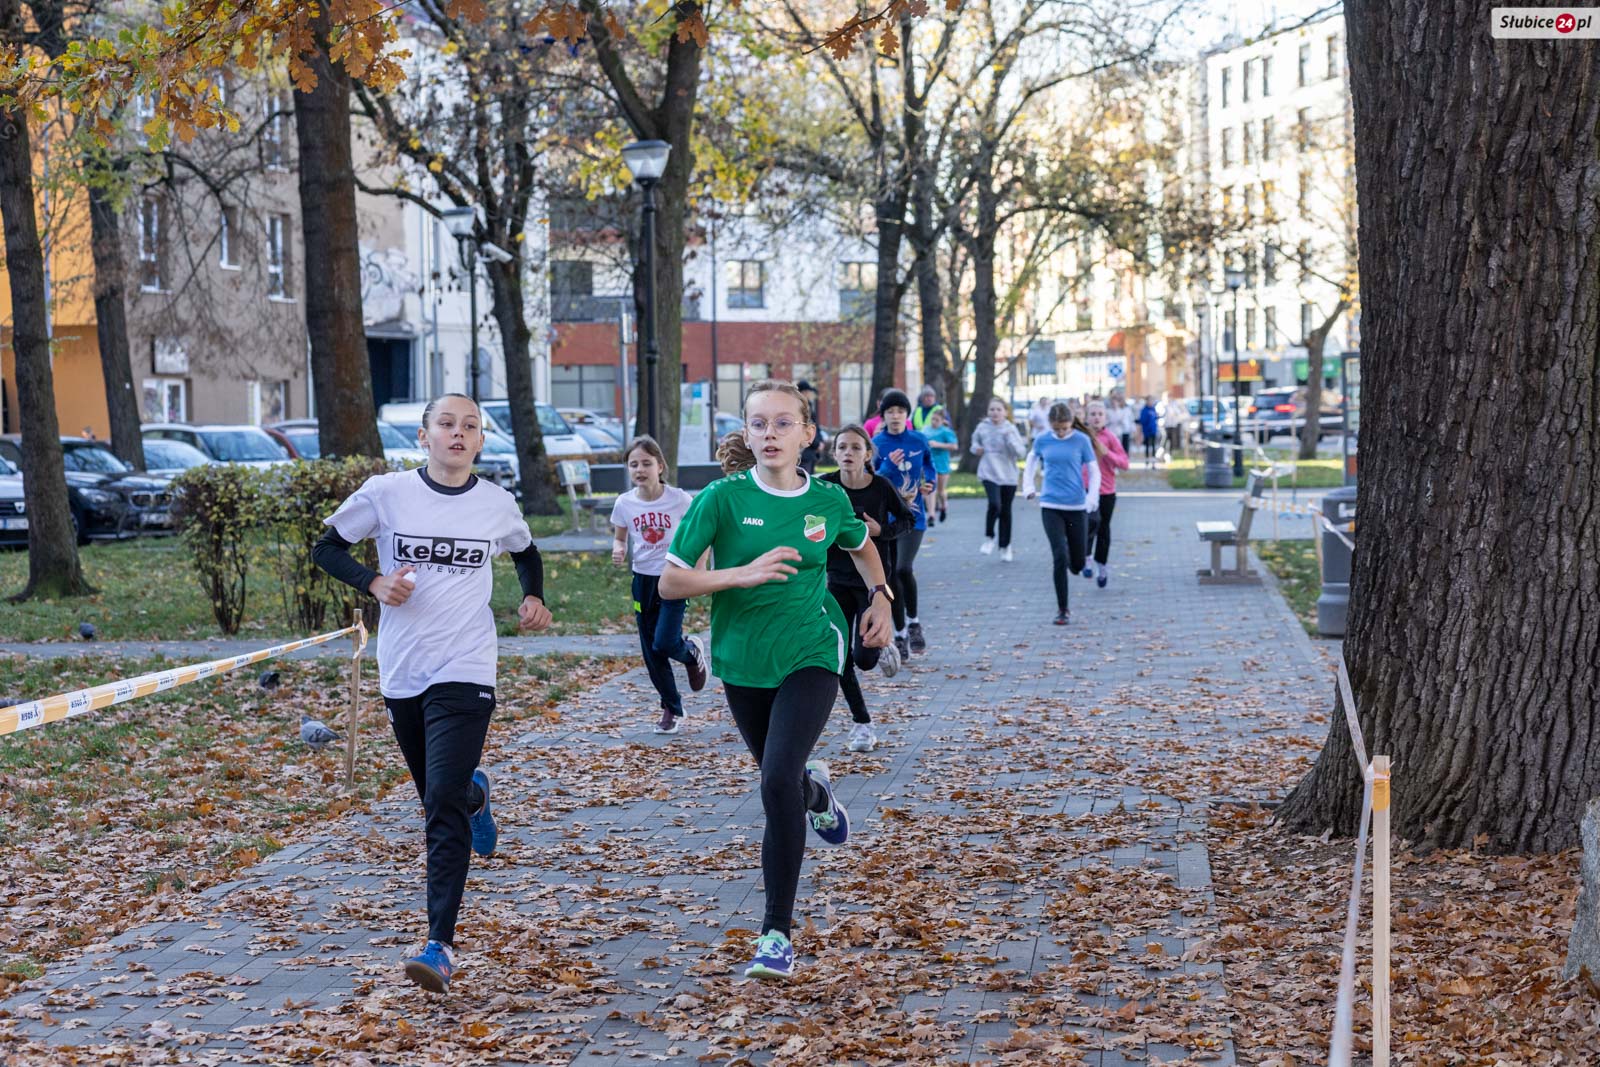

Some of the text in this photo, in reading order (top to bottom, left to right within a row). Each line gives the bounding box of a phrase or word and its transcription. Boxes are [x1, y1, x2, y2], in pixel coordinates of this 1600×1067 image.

[633, 511, 671, 532] PARIS
[742, 517, 764, 527] JAKO
[397, 538, 484, 564] keeza
